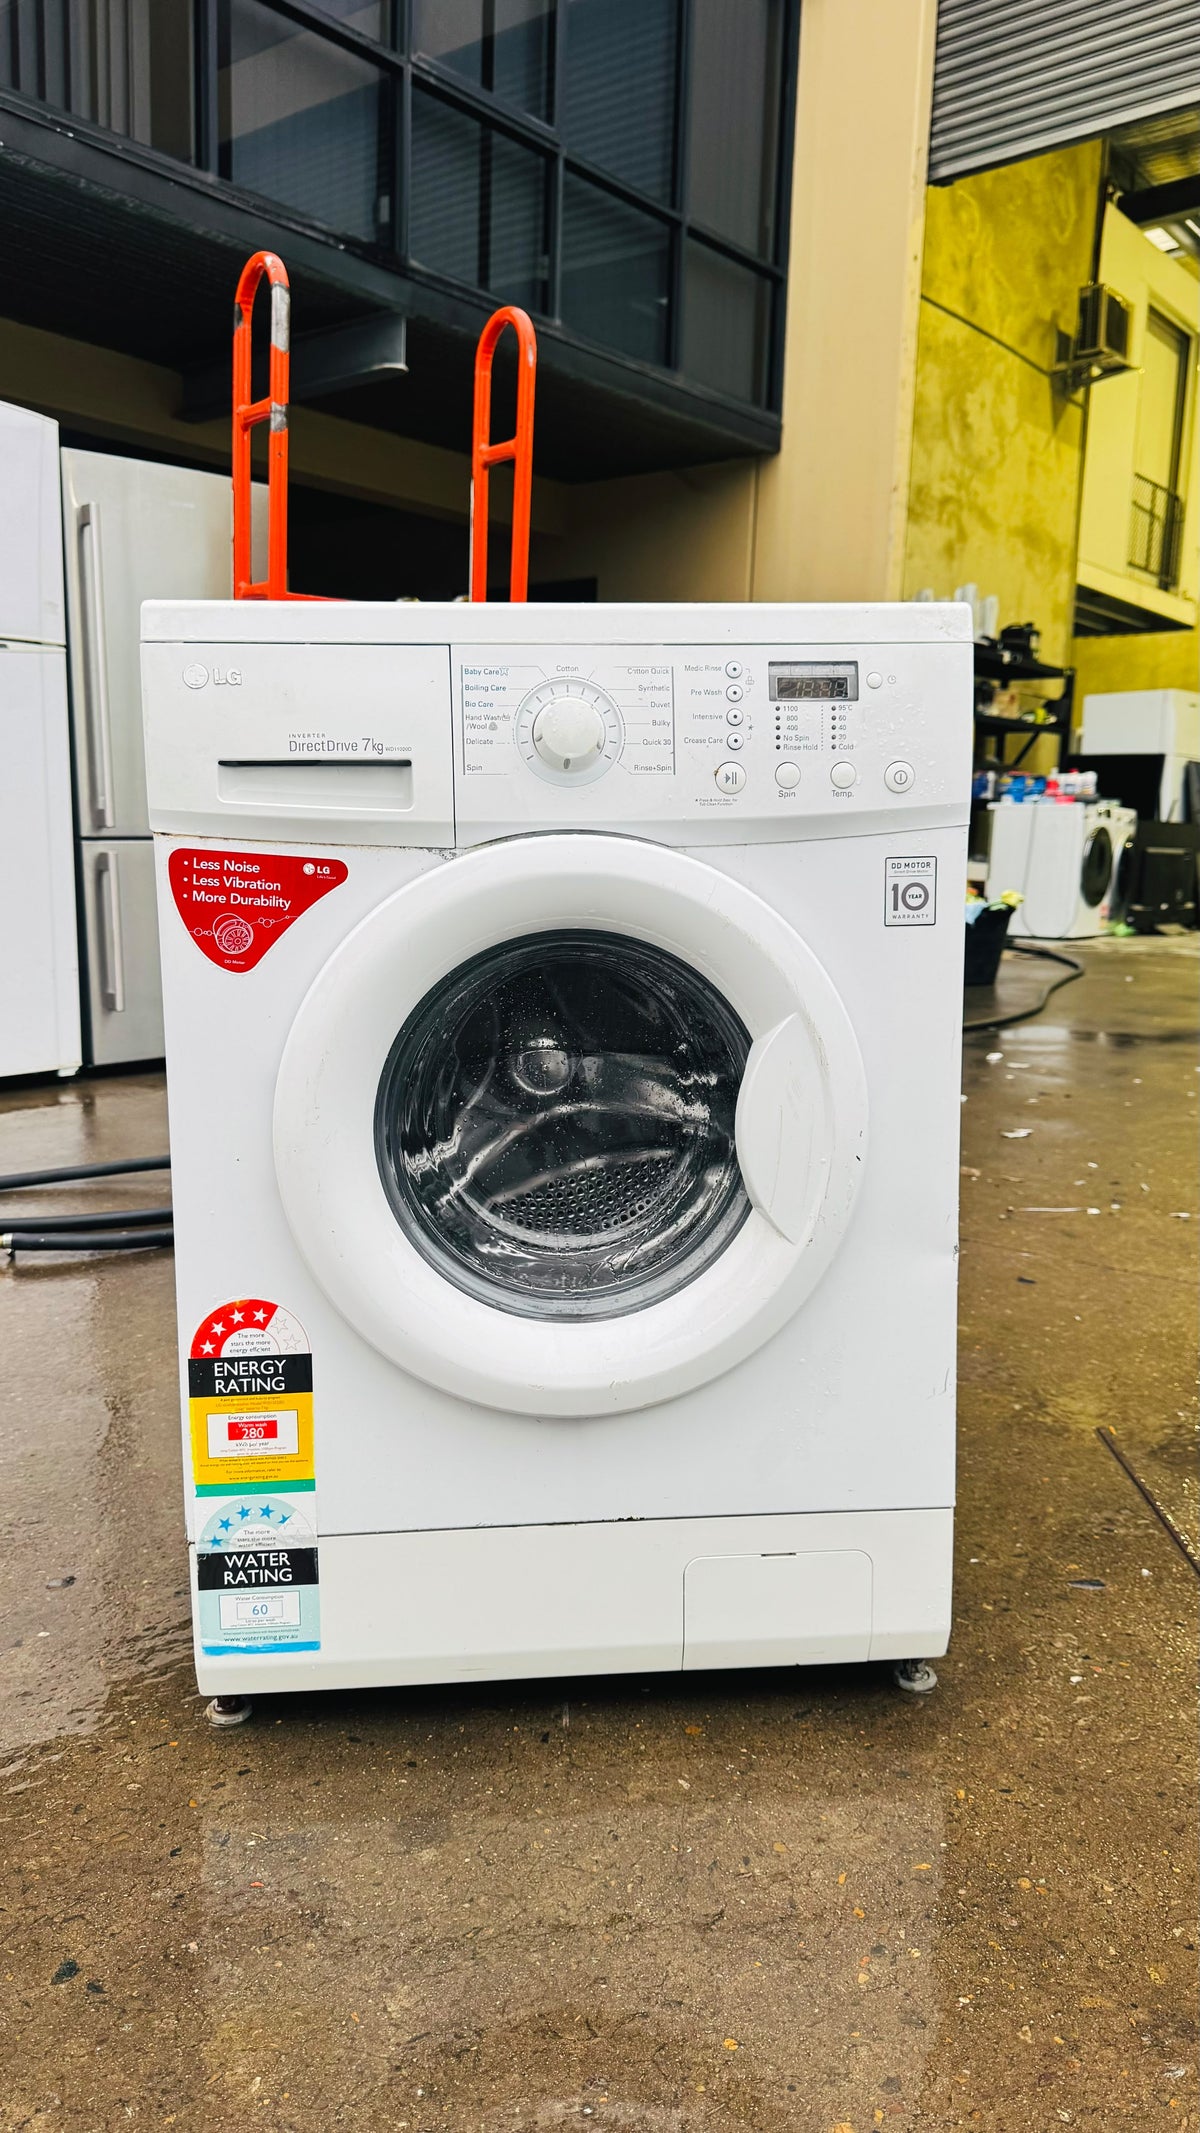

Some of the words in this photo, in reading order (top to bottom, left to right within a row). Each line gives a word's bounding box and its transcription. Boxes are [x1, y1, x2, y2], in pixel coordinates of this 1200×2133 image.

[212, 668, 242, 686] LG
[362, 738, 384, 755] 7kg
[466, 764, 483, 772] Spin
[778, 790, 796, 799] Spin
[832, 790, 854, 798] Temp.
[193, 857, 220, 871] Less
[224, 860, 260, 873] Noise
[317, 866, 330, 874] LG
[193, 874, 220, 887] Less
[223, 876, 281, 891] Vibration
[192, 891, 226, 904] More
[230, 893, 291, 911] Durability
[891, 882, 929, 911] 10
[214, 1360, 286, 1377] ENERGY
[215, 1377, 285, 1394] RATING
[242, 1428, 264, 1439] 280
[224, 1552, 290, 1568] WATER
[224, 1568, 293, 1585] RATING
[252, 1604, 268, 1616] 60
